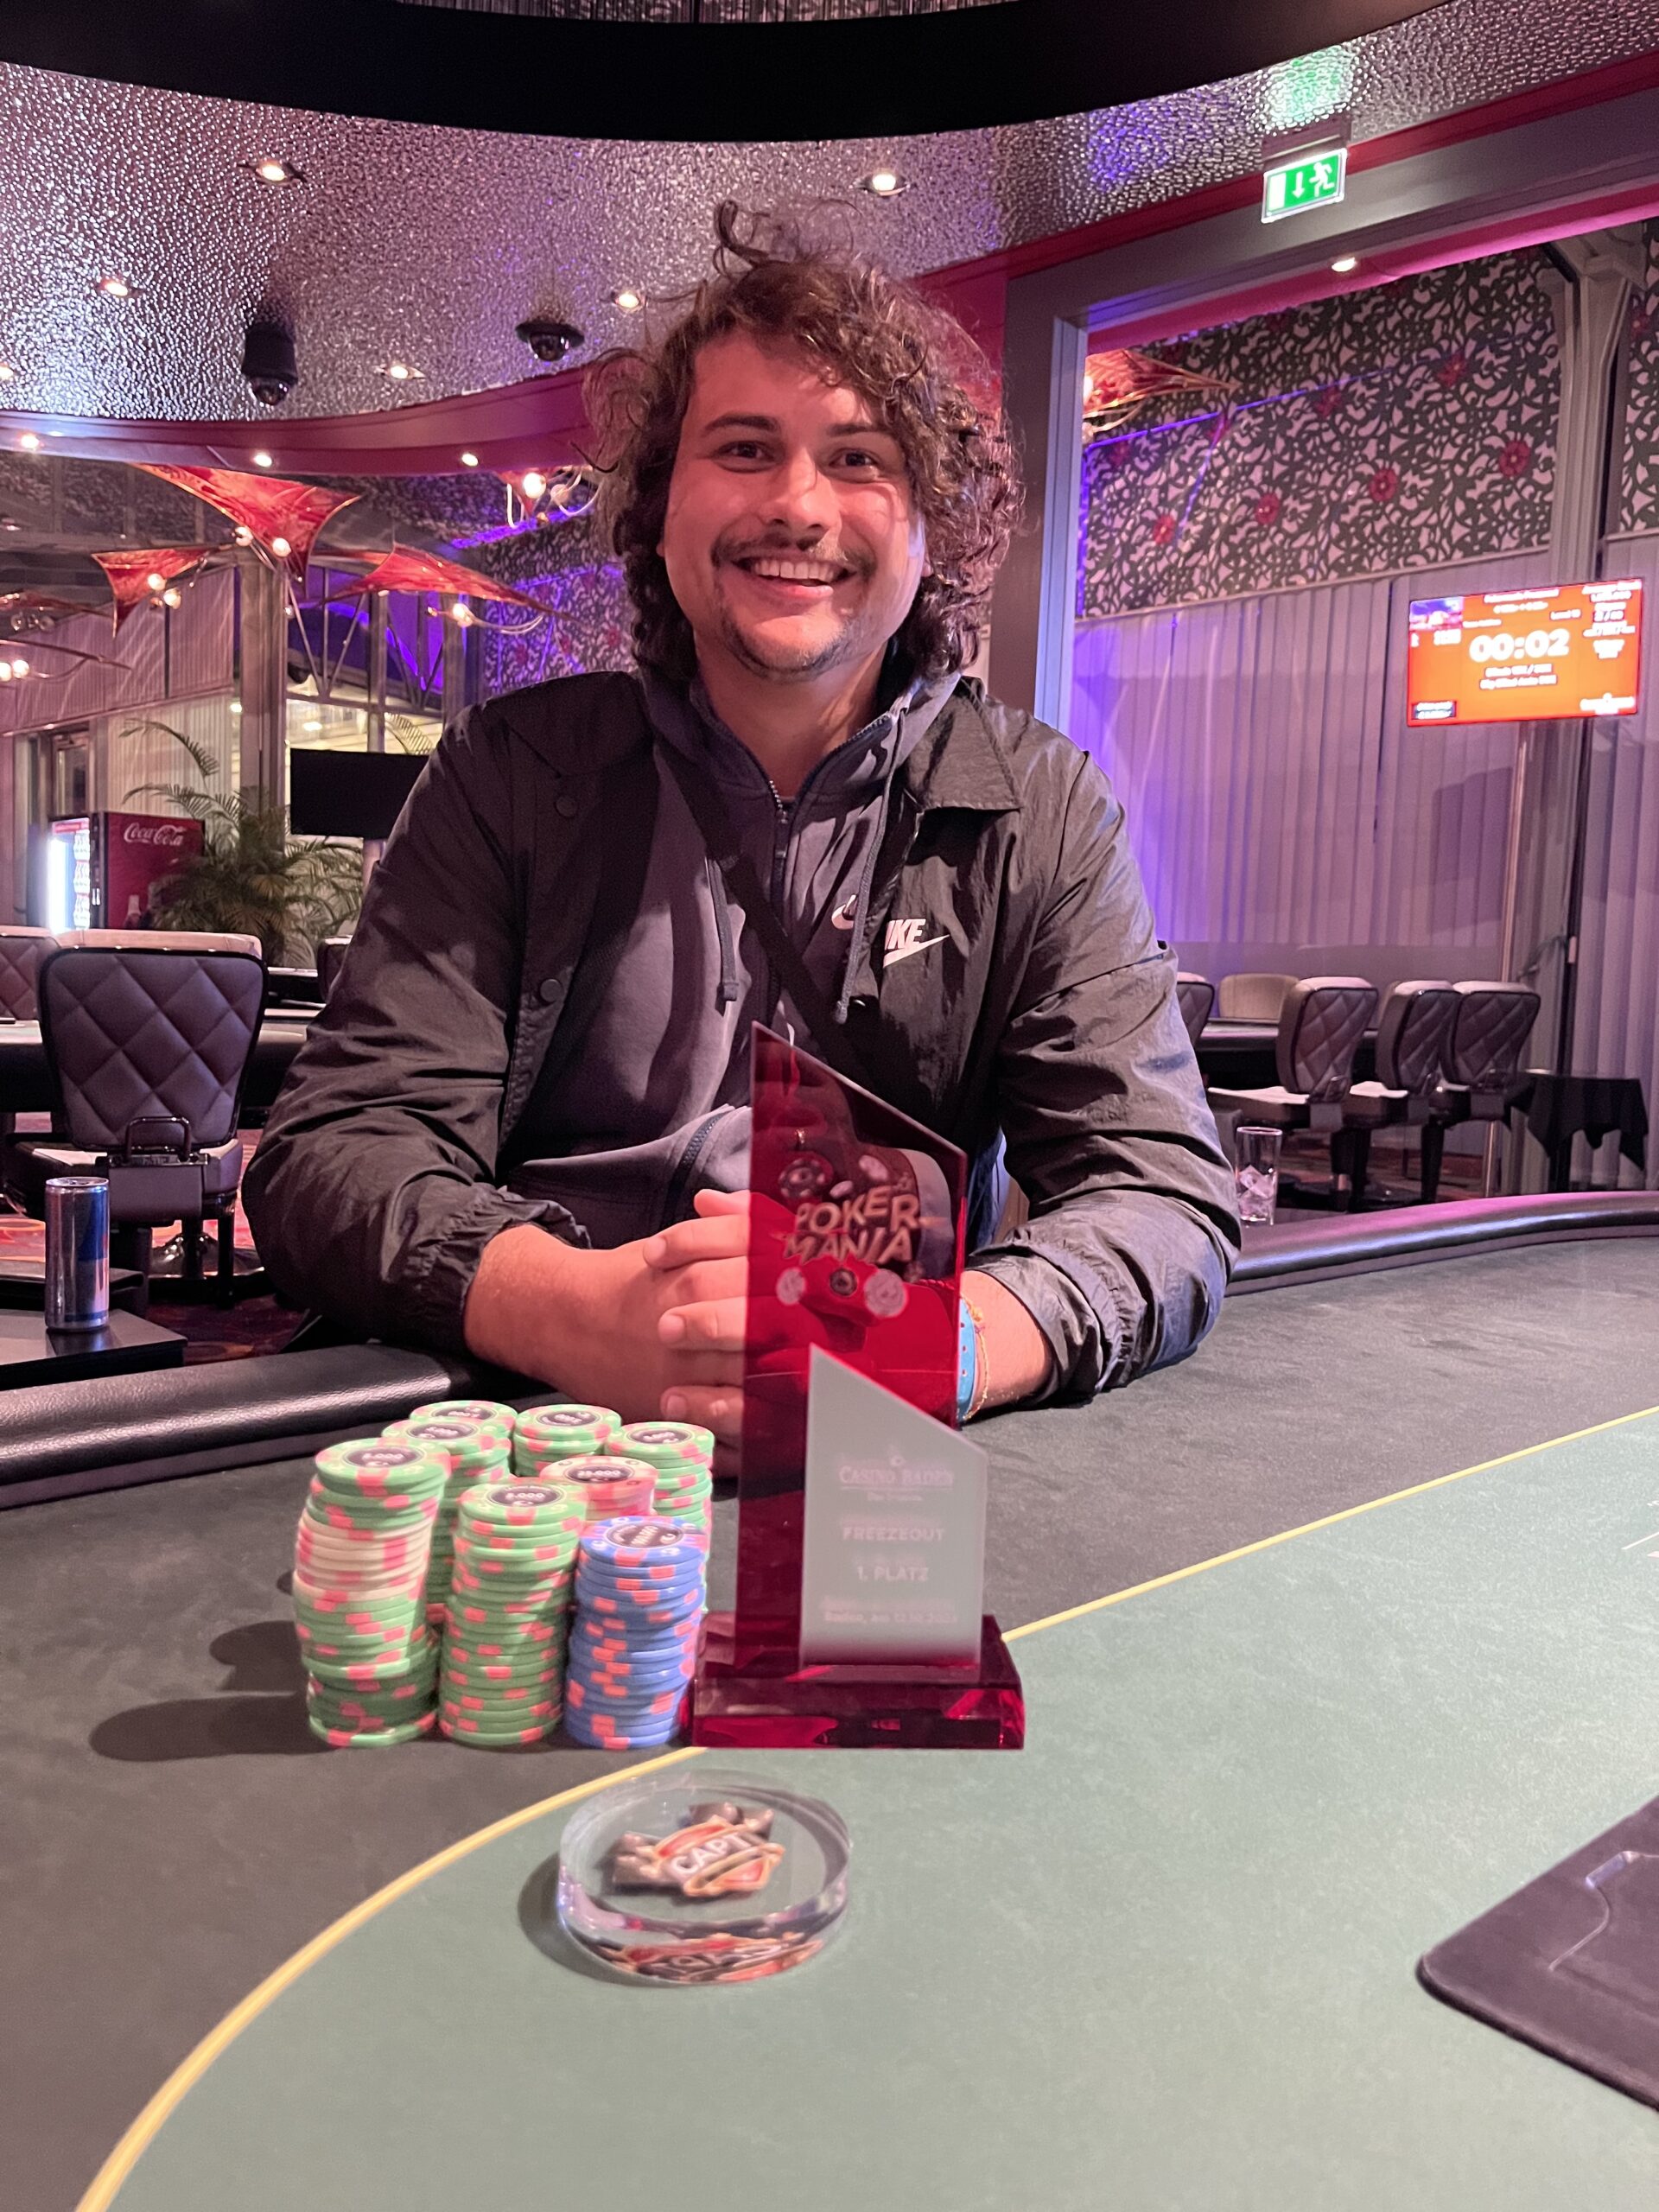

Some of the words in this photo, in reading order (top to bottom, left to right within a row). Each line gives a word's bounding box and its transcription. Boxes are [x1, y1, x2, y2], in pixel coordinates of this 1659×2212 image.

[1470, 628, 1570, 662] 00:02
[884, 918, 926, 950] IKE
[796, 1185, 921, 1235] POKER
[784, 1225, 912, 1266] MANIA
[842, 1527, 945, 1541] FREEZEOUT
[874, 1565, 930, 1582] PLATZ
